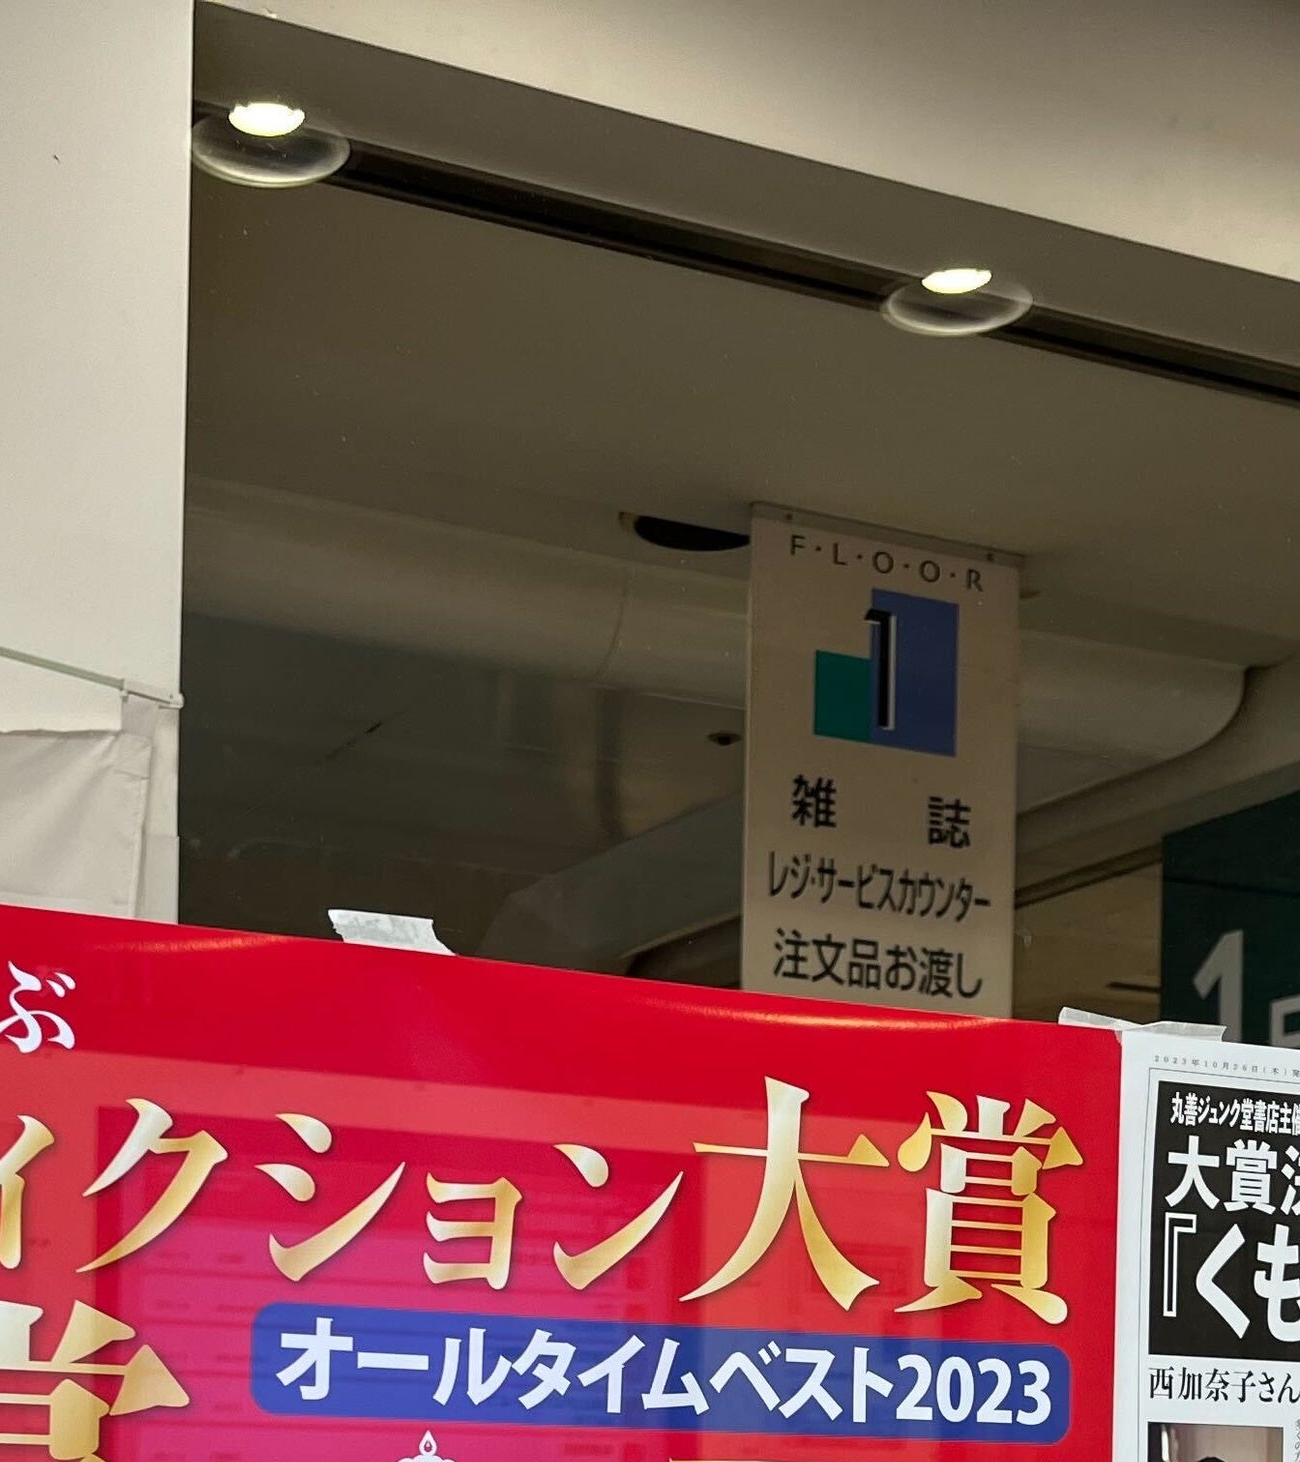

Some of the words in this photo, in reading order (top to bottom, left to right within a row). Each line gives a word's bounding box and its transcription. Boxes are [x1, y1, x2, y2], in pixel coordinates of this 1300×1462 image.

[863, 608, 898, 731] 1
[773, 928, 983, 999] 注文品お渡し
[275, 1316, 1053, 1426] オールタイムベスト2023
